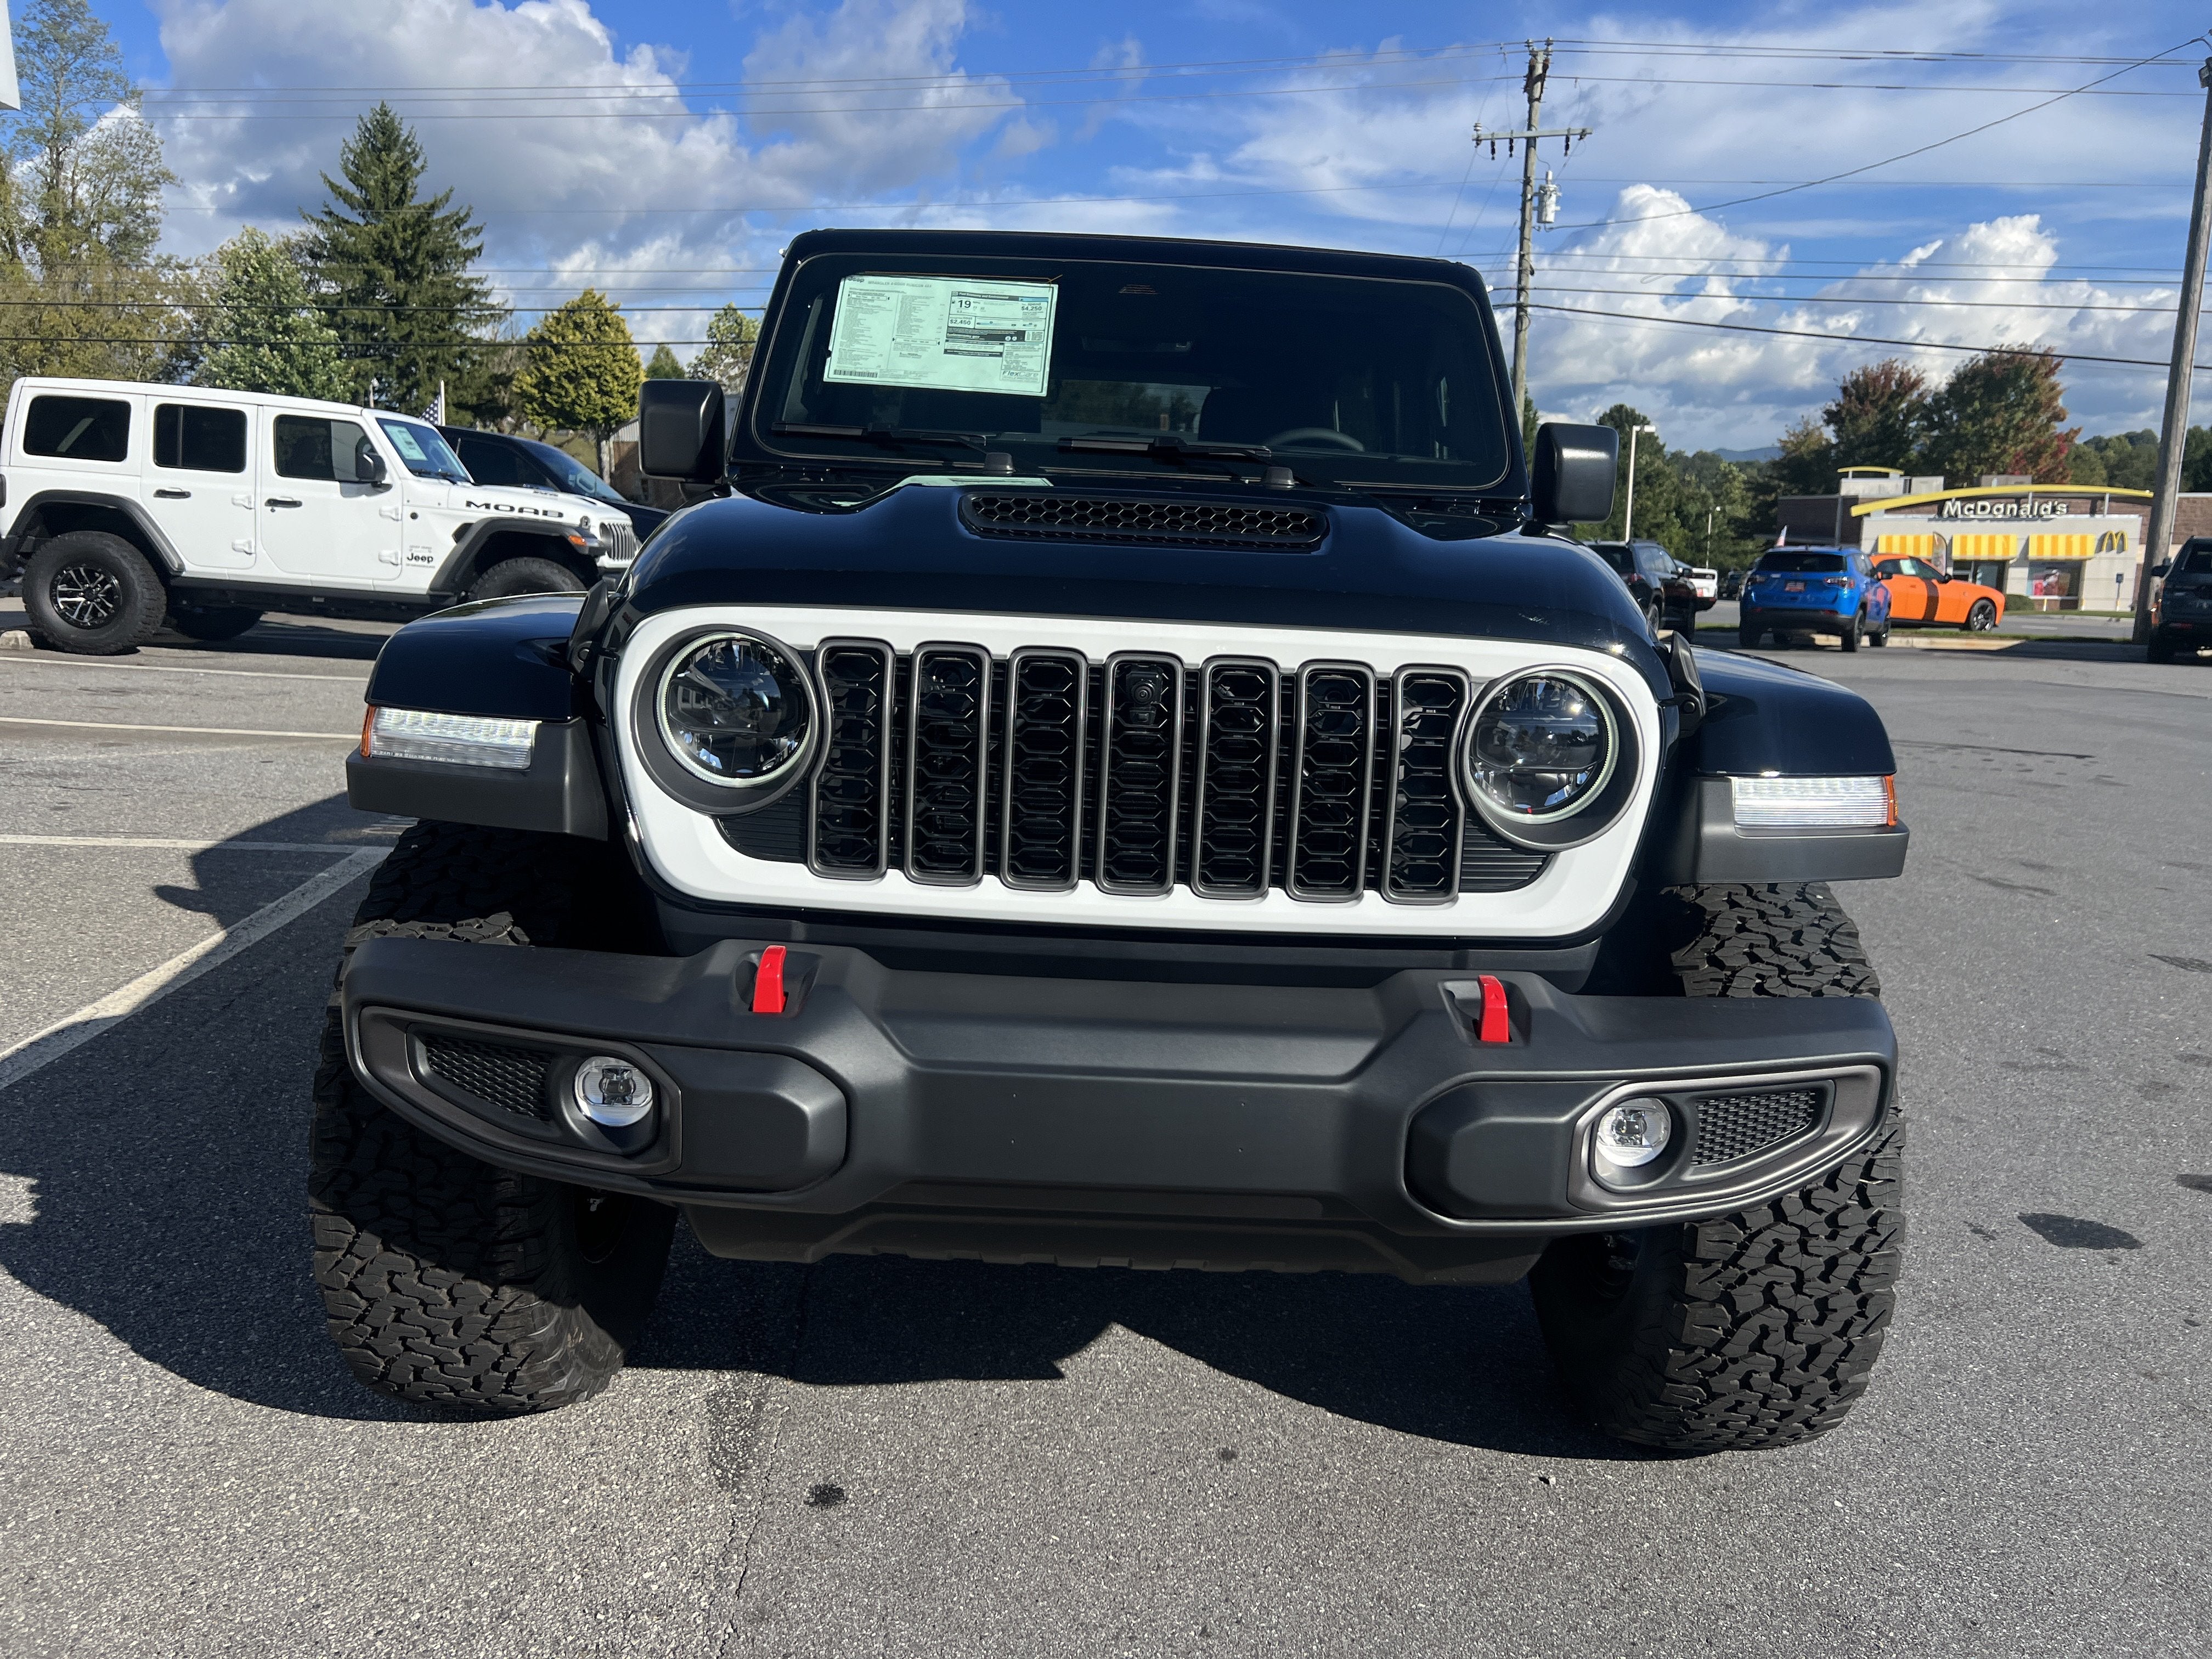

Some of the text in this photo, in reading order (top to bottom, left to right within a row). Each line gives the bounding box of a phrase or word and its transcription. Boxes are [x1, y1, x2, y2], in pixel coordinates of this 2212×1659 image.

[958, 300, 971, 308] 19
[1942, 500, 2068, 518] McDonald's
[407, 553, 433, 564] Jeep
